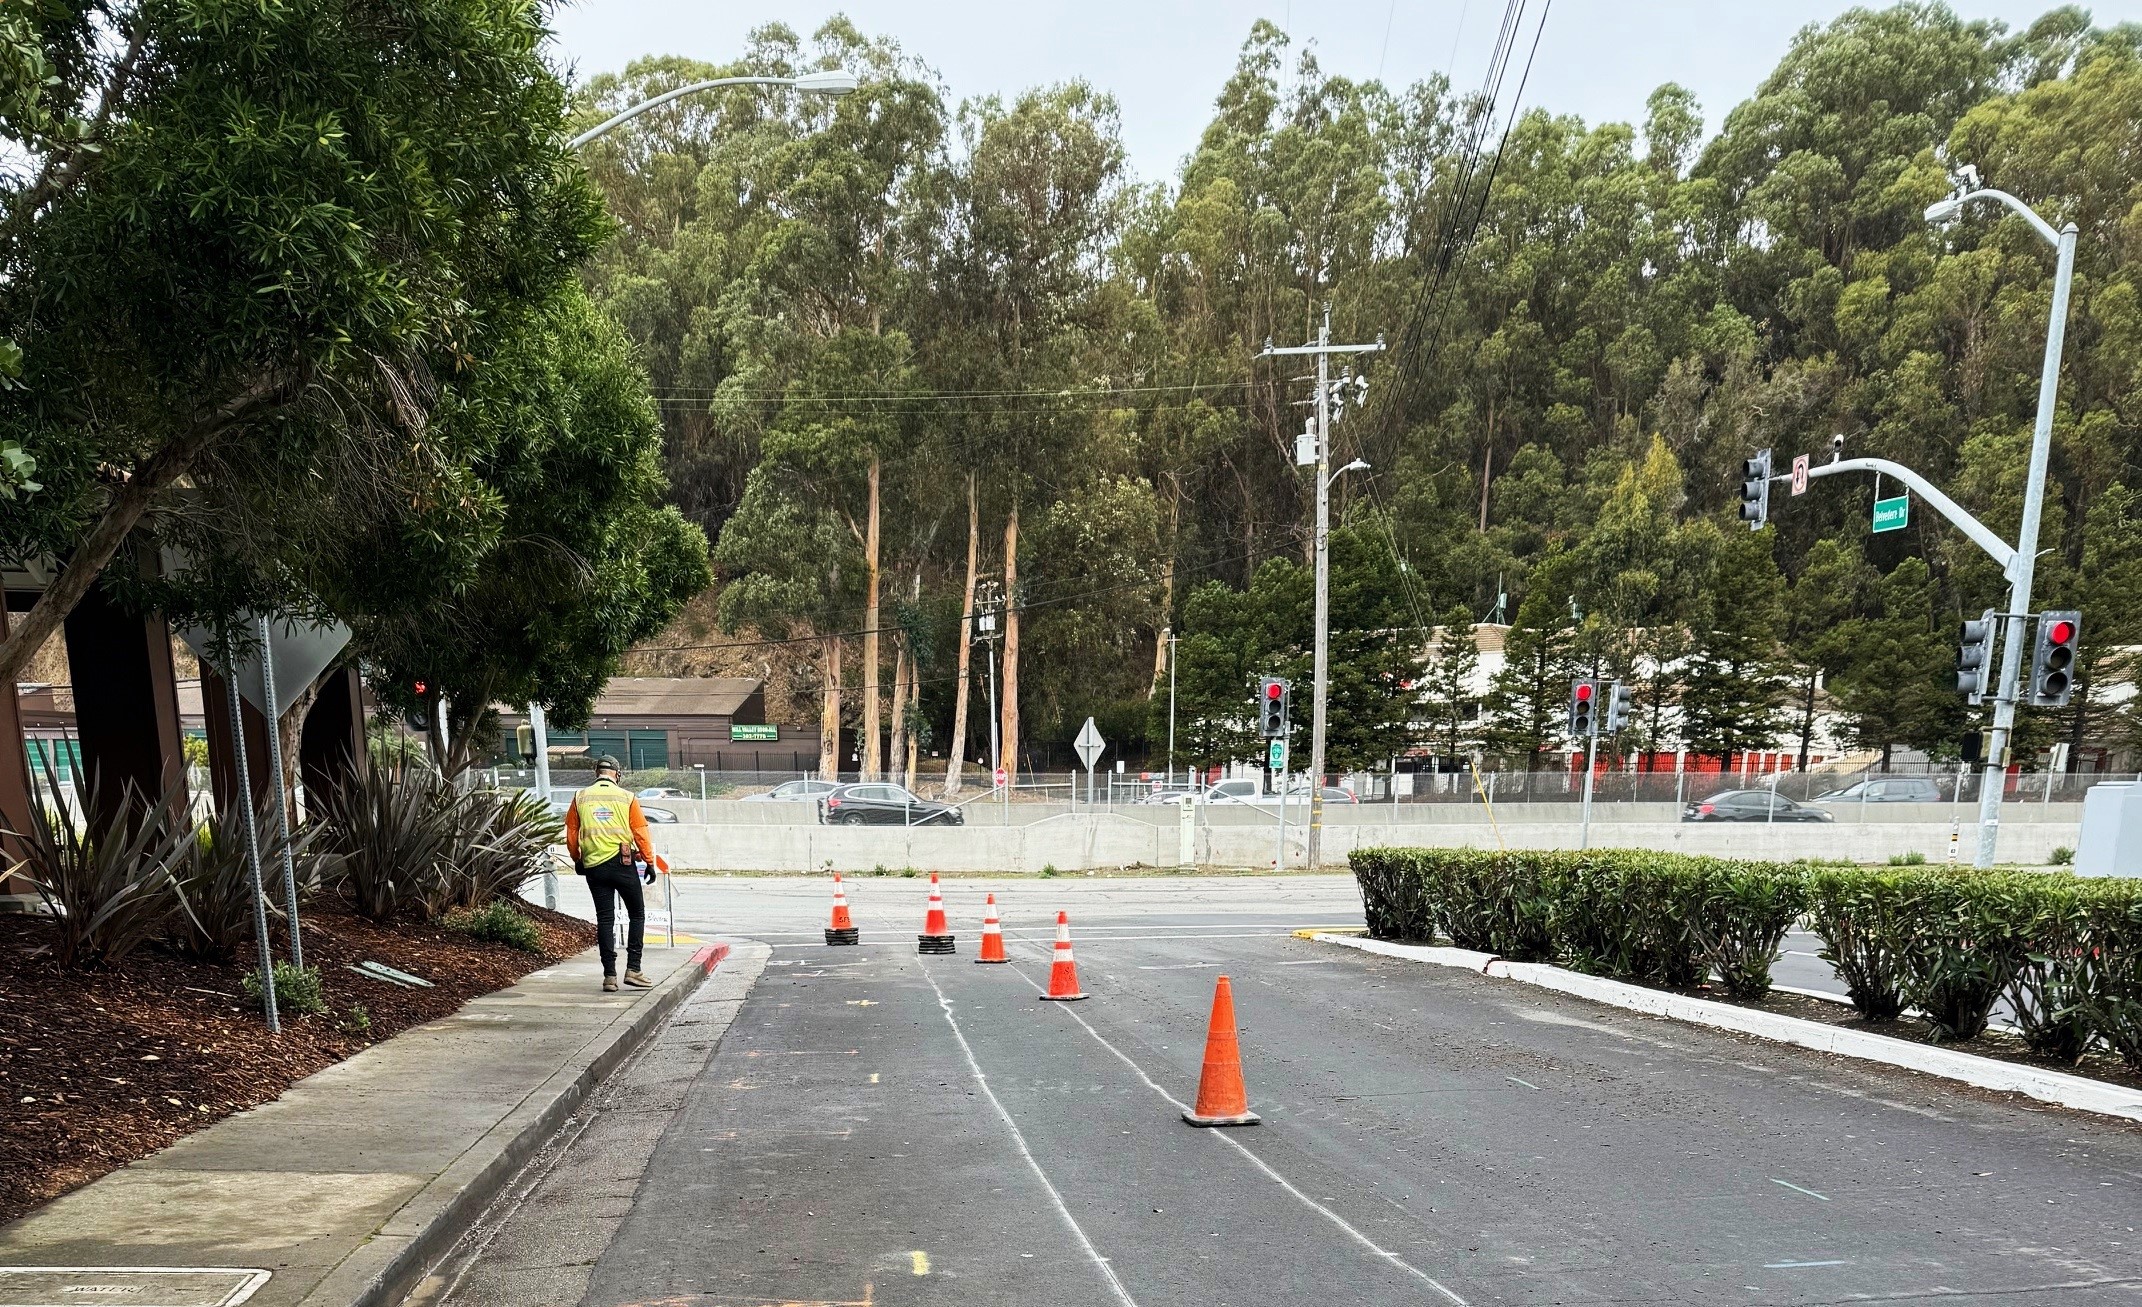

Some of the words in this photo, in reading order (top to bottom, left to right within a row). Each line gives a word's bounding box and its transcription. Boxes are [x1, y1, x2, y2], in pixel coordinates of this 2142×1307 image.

[1875, 509, 1898, 523] Belvedere
[1898, 506, 1906, 519] Dr
[71, 1285, 134, 1293] WATER
